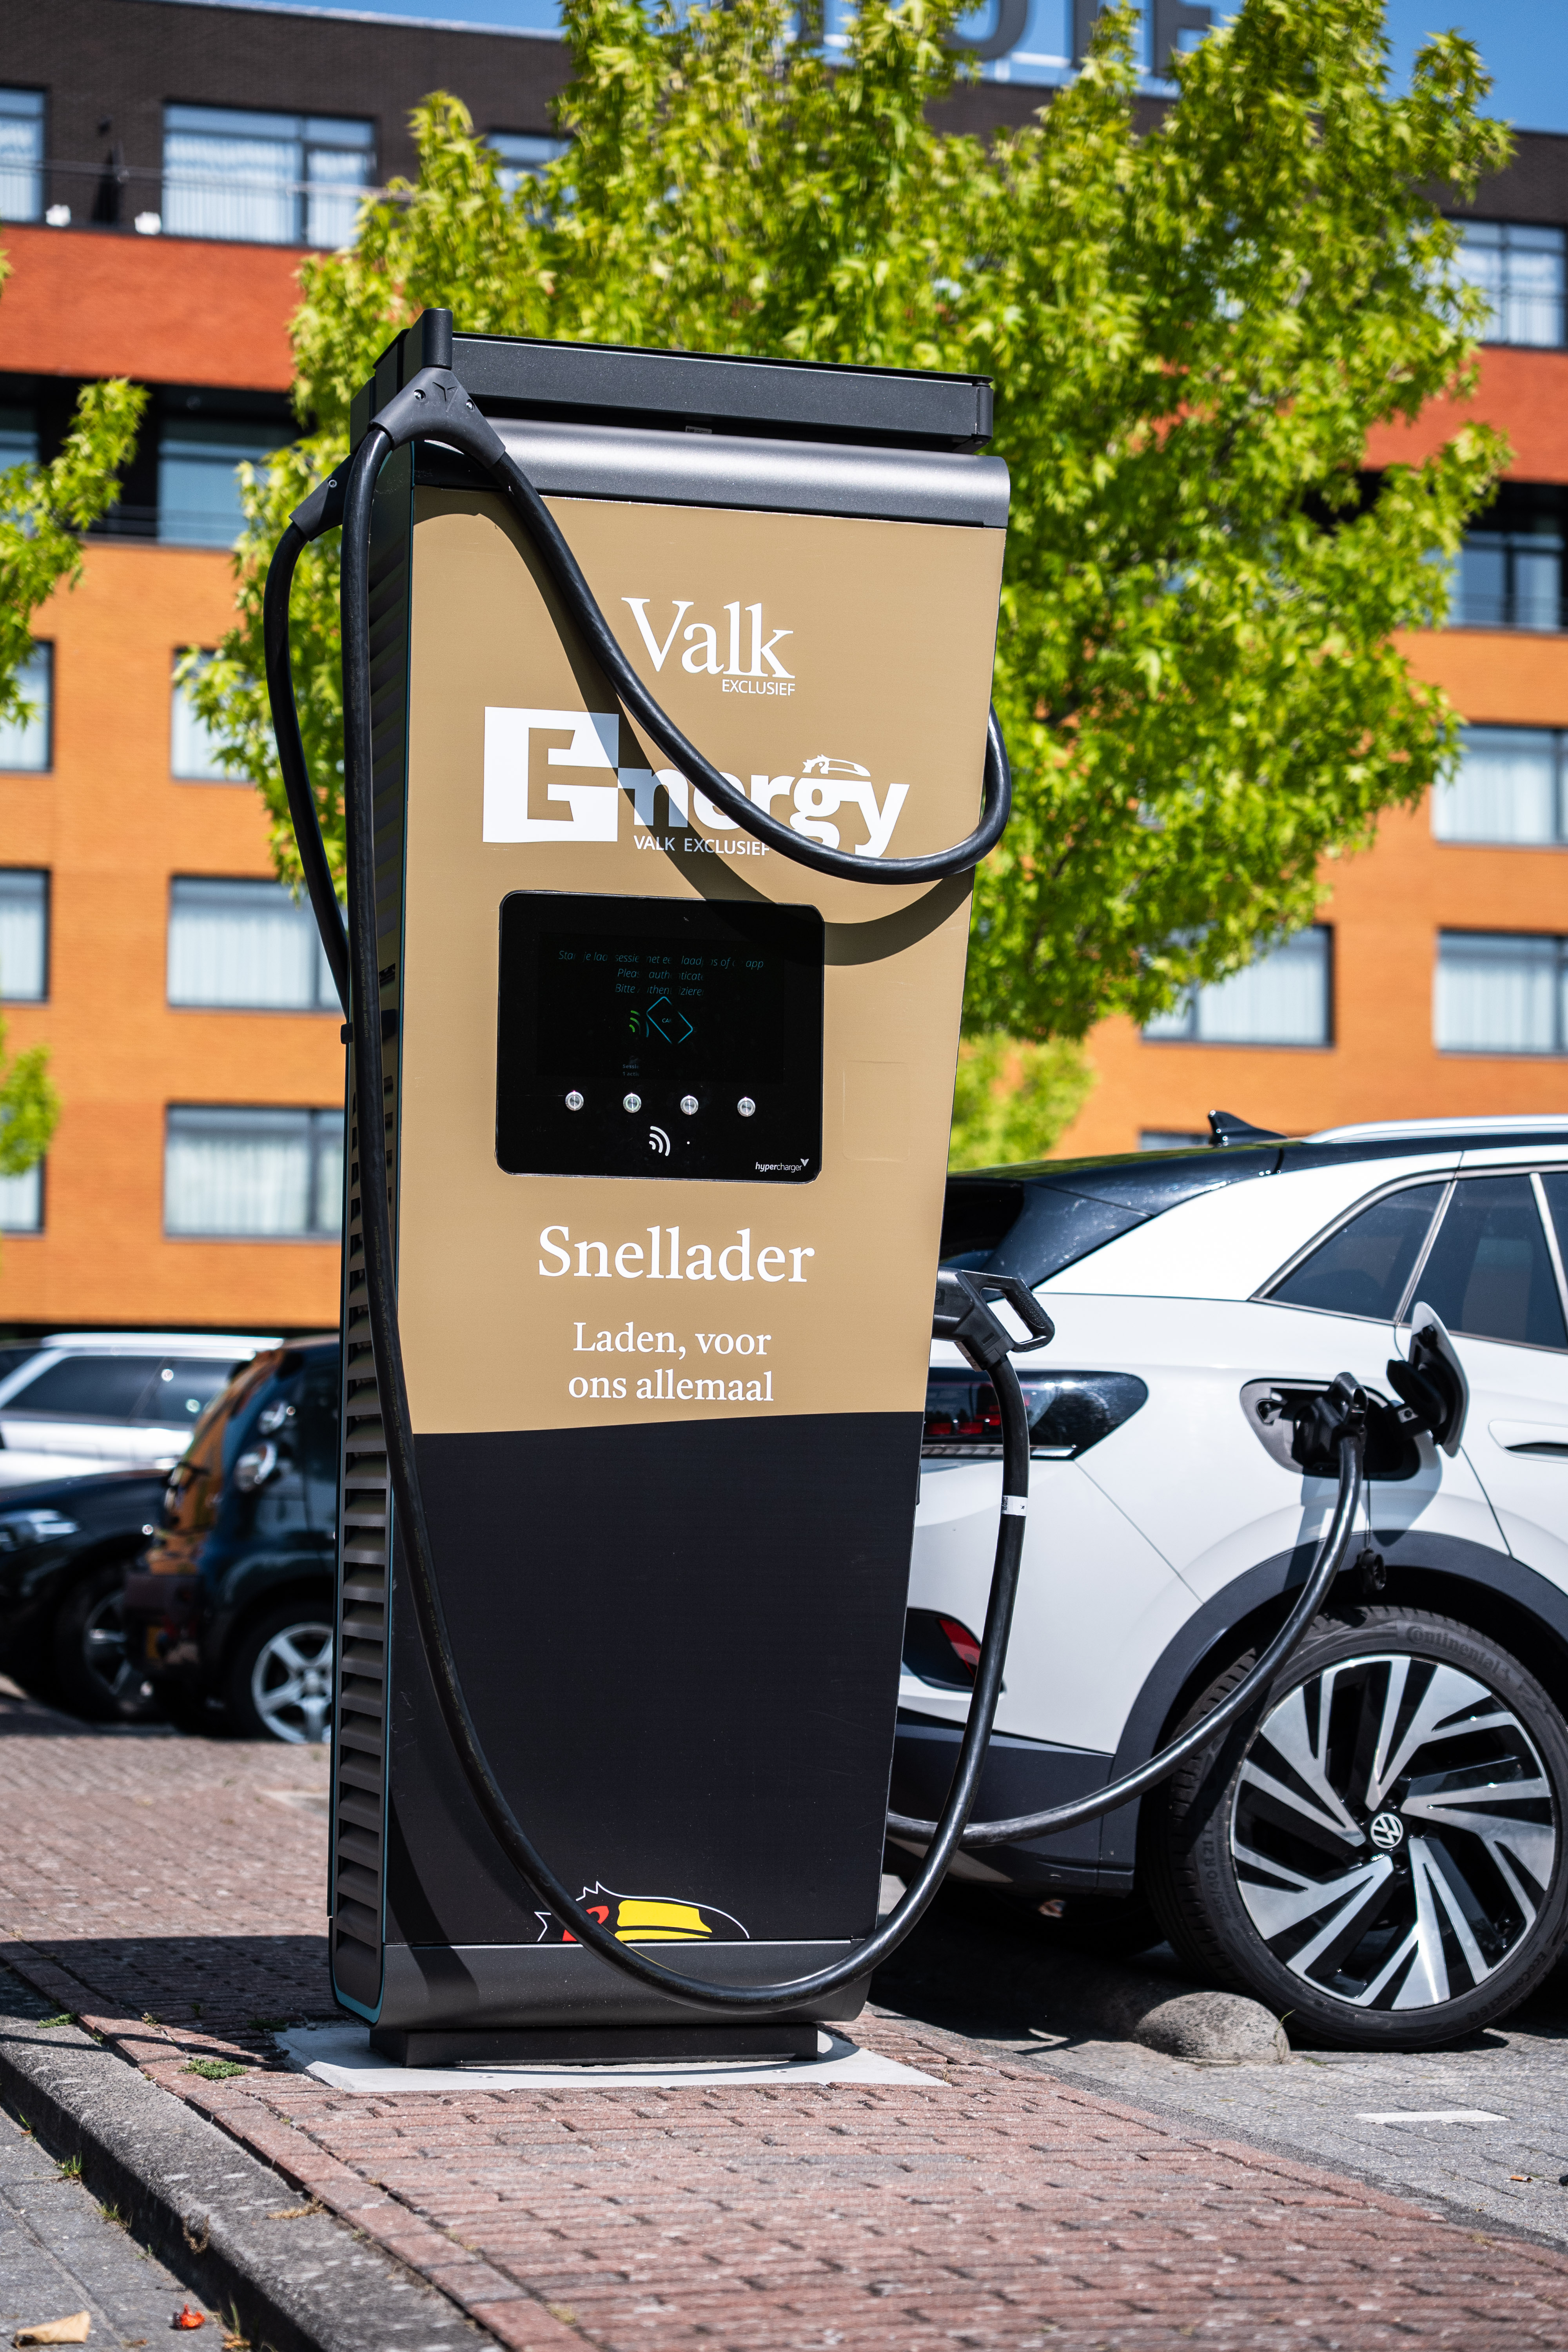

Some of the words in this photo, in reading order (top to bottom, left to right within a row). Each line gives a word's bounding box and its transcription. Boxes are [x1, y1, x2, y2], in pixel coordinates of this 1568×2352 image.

[621, 597, 795, 679] Valk
[722, 679, 795, 695] EXCLUSIEF
[634, 835, 675, 851] VALK
[684, 838, 769, 856] EXCLUSIEF
[746, 960, 764, 970] app
[615, 983, 636, 993] Bitte
[755, 1161, 802, 1173] hypercharger
[539, 1225, 815, 1282] Snellader
[573, 1321, 686, 1360] Laden,
[695, 1334, 771, 1355] voor
[568, 1377, 627, 1399] ons
[636, 1368, 774, 1401] allemaal
